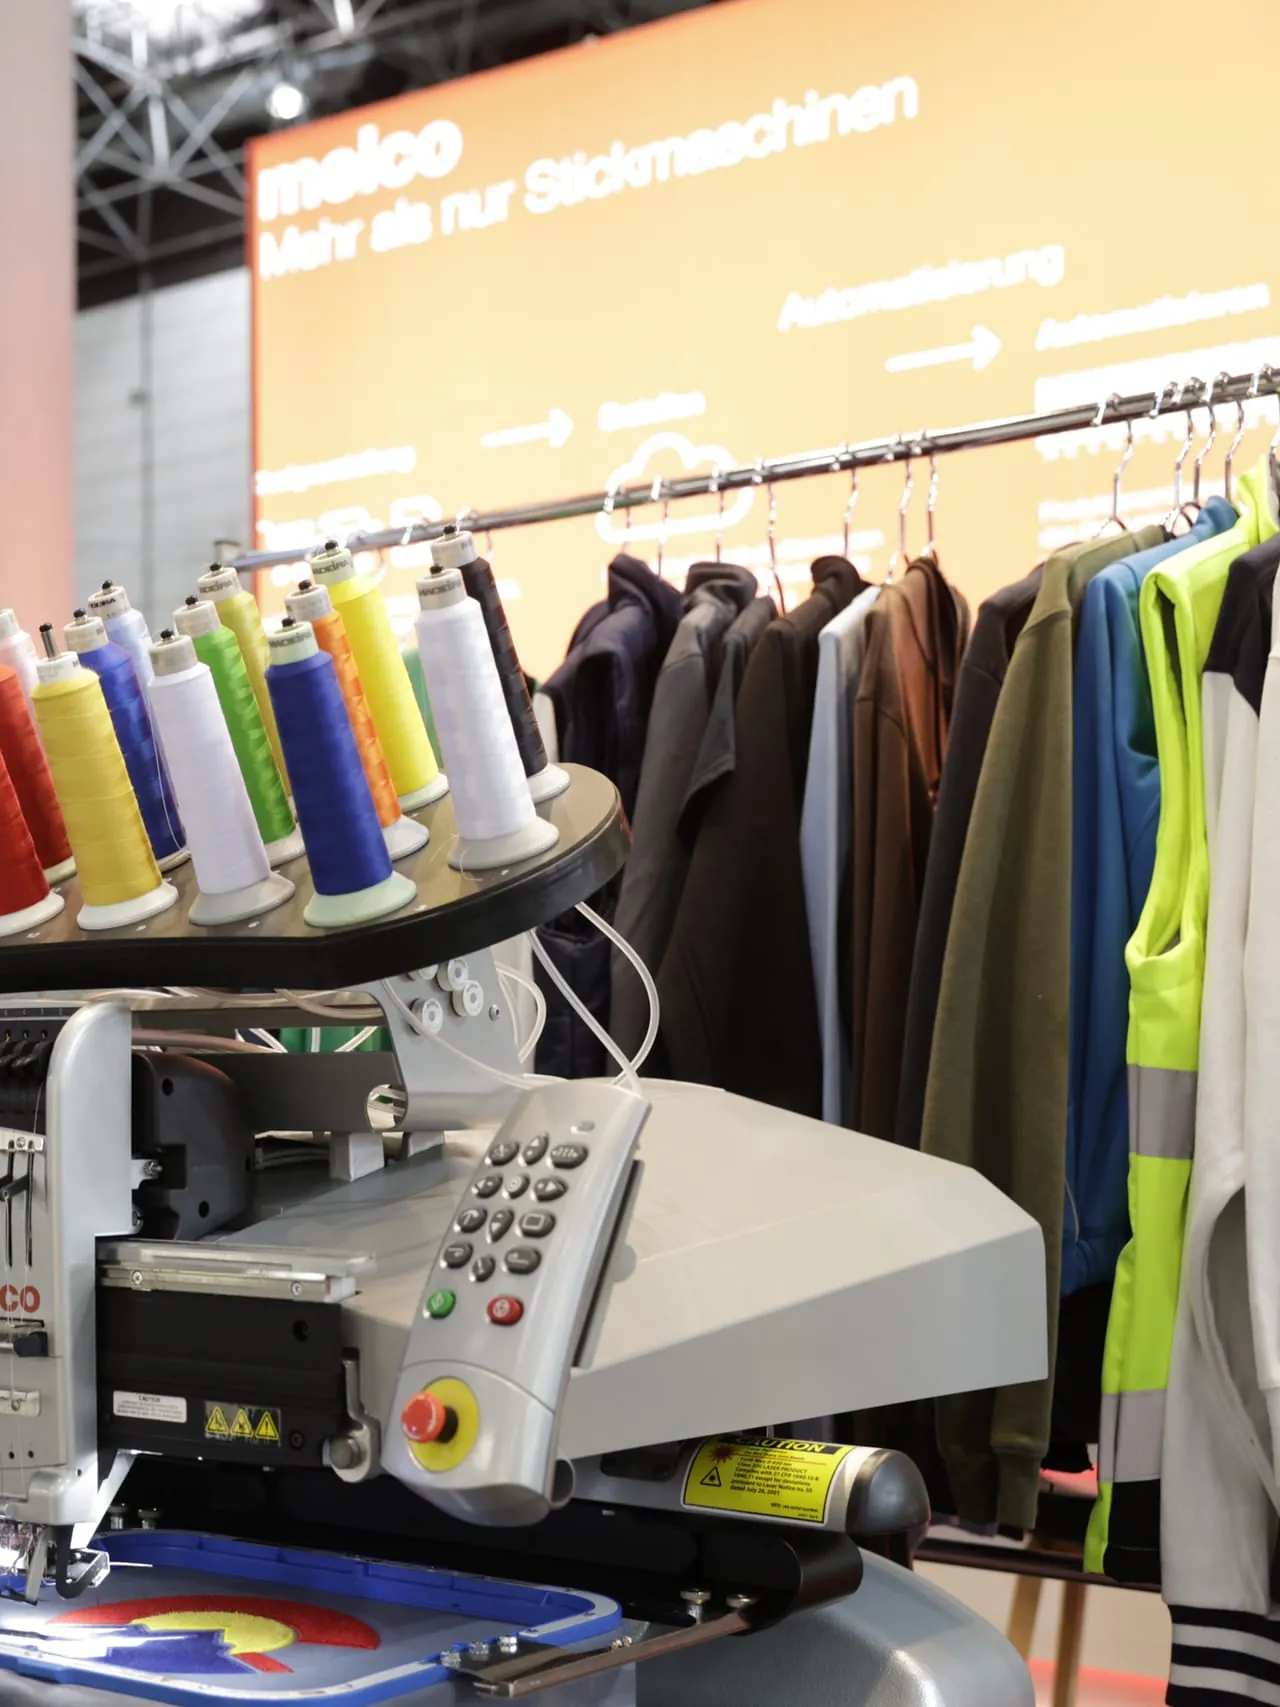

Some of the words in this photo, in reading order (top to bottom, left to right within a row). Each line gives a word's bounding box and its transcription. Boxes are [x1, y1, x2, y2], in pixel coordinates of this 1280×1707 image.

[257, 119, 463, 222] melco
[258, 217, 364, 280] Mehr
[370, 196, 433, 252] als
[440, 180, 516, 235] nur
[523, 75, 919, 214] Stickmaschinen
